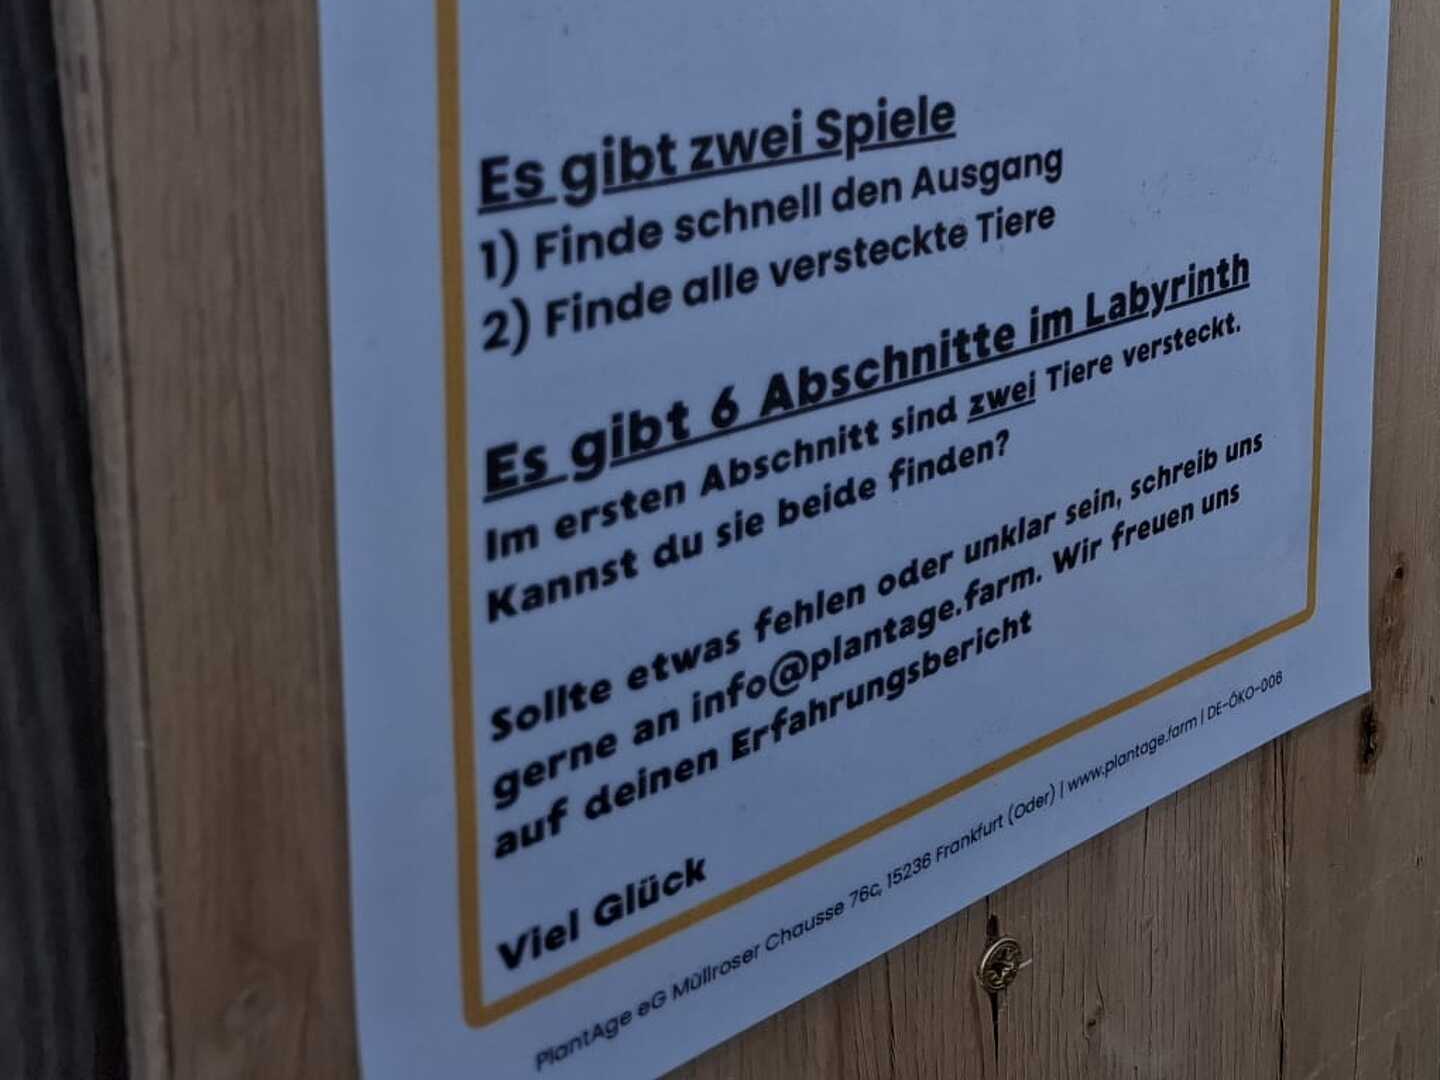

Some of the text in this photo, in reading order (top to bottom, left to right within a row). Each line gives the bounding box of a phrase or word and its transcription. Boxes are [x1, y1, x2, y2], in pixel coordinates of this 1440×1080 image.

[479, 147, 1064, 287] 1) Finde schnell den Ausgang
[480, 95, 956, 208] Es gibt zwei Spiele
[482, 204, 1056, 356] 2) Finde alle versteckte Tiere
[485, 252, 1251, 494] Es gibt 6 Abschnitte im Labyrinth
[486, 311, 1242, 563] Im ersten Abschnitt sind zwei Tiere versteckt.
[487, 428, 1010, 624] Kannst du sie beide finden?
[490, 432, 1263, 743] Sollte etwas fehlen oder unklar sein, schreib uns
[493, 483, 1240, 809] gerne an info@plantage.farm. Wir freuen uns
[495, 610, 1033, 860] auf deinen Erfahrungsbericht
[497, 855, 707, 971] Viel Glück
[535, 1008, 632, 1072] PlantAge
[637, 990, 667, 1017] eG
[673, 942, 761, 1002] Müllroser
[765, 902, 844, 951] Chausse
[886, 853, 932, 889] 15236
[936, 805, 1003, 863] Frankfurt
[1008, 783, 1056, 826] (Oder)
[1066, 716, 1198, 791] www.plantage.farm
